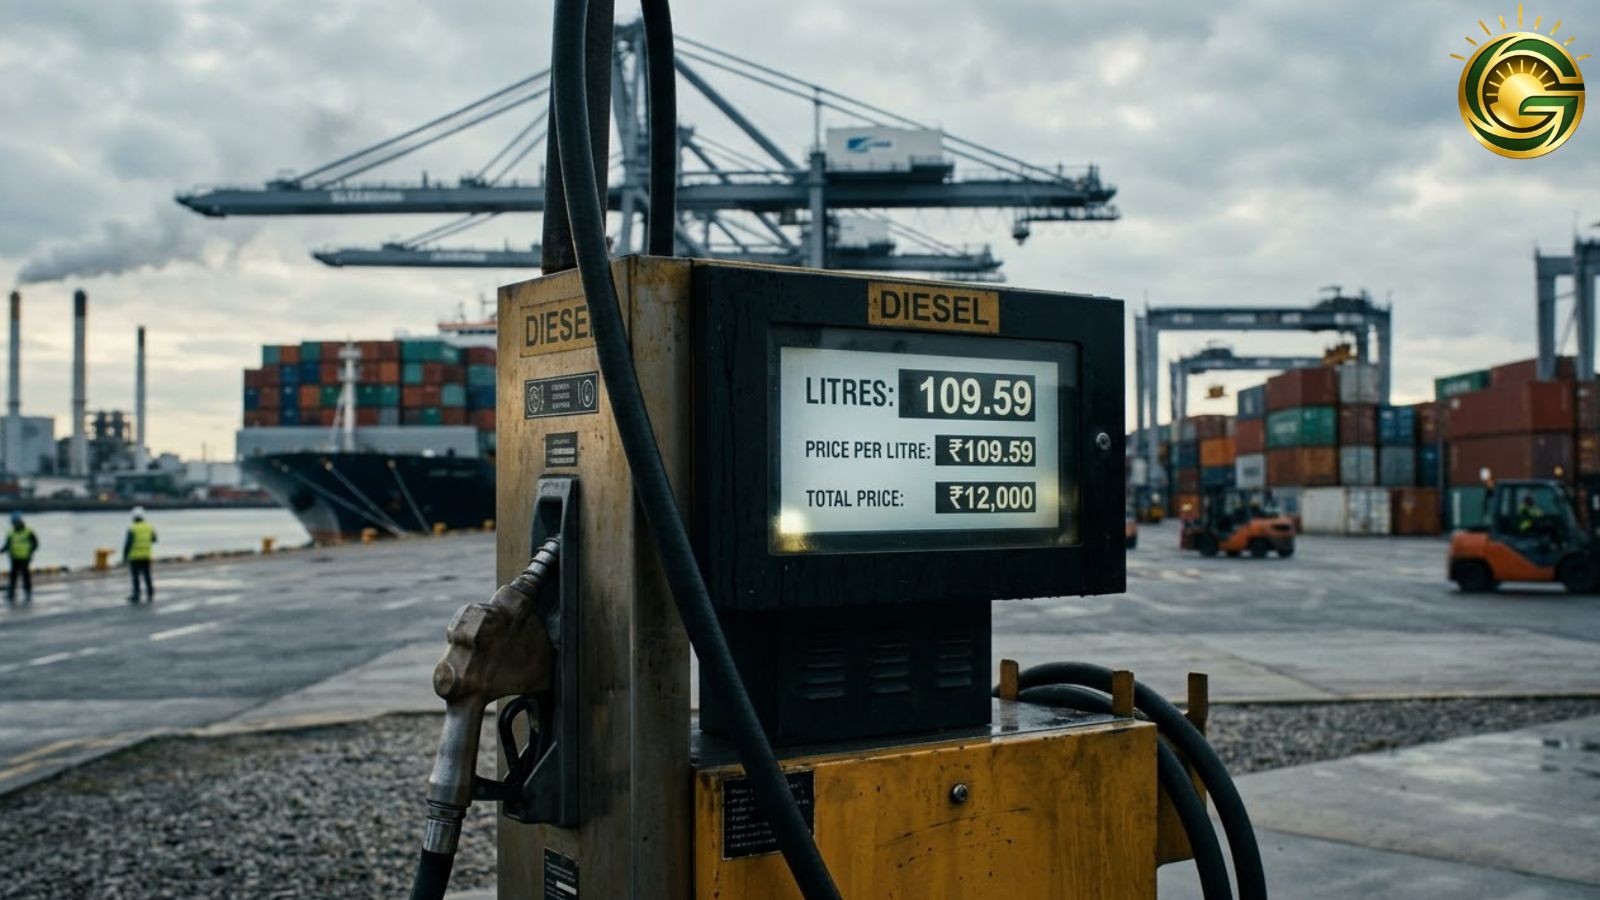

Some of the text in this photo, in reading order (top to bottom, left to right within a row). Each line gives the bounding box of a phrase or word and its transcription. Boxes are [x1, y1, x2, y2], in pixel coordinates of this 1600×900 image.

[880, 290, 989, 325] DIESEL
[525, 304, 593, 347] DIESE
[806, 375, 1033, 417] LITRES: 109.59
[805, 438, 1033, 463] PRICE PER LITRE: ₹109.59
[806, 485, 1033, 513] TOTAL PRICE: ₹12,000
